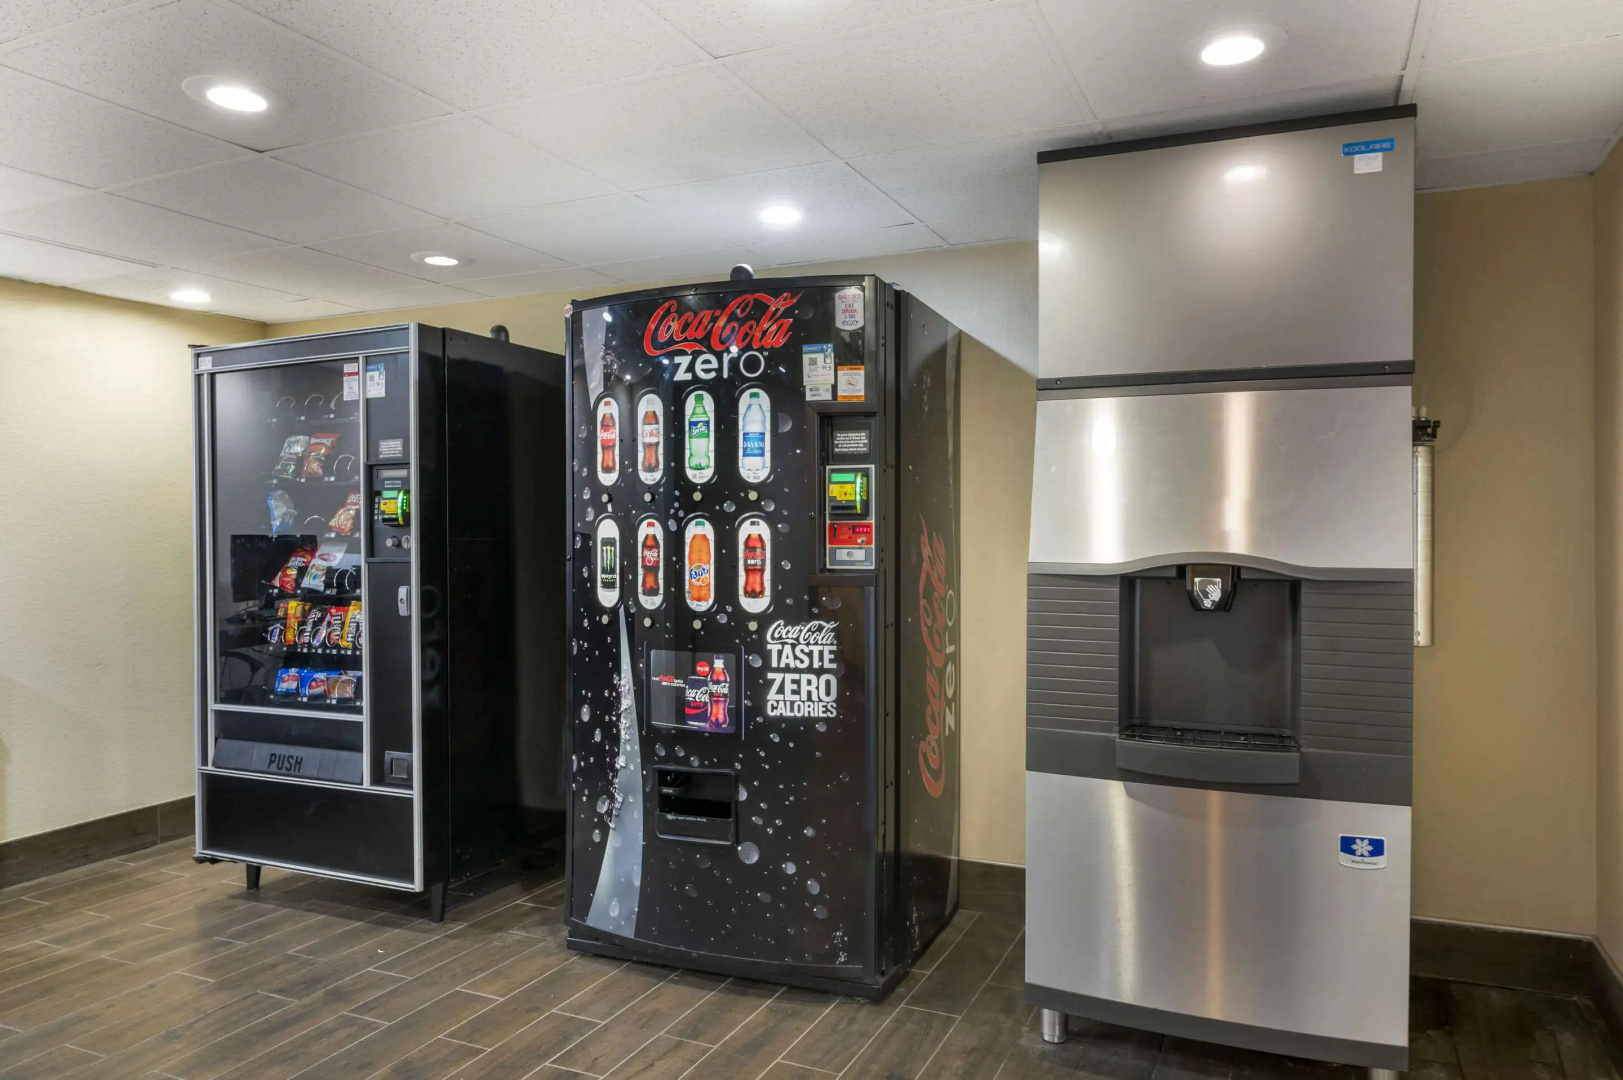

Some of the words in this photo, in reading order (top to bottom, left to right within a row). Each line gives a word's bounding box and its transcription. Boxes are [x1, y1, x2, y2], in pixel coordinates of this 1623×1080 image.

[643, 291, 803, 356] Coca-Cola
[673, 351, 765, 381] zero
[691, 424, 708, 436] Sprite
[766, 620, 839, 644] Coca-Cola
[766, 644, 837, 669] TASTE
[945, 590, 956, 736] zero
[767, 673, 837, 702] ZERO
[767, 701, 837, 717] CALORIES
[268, 752, 303, 773] PUSH
